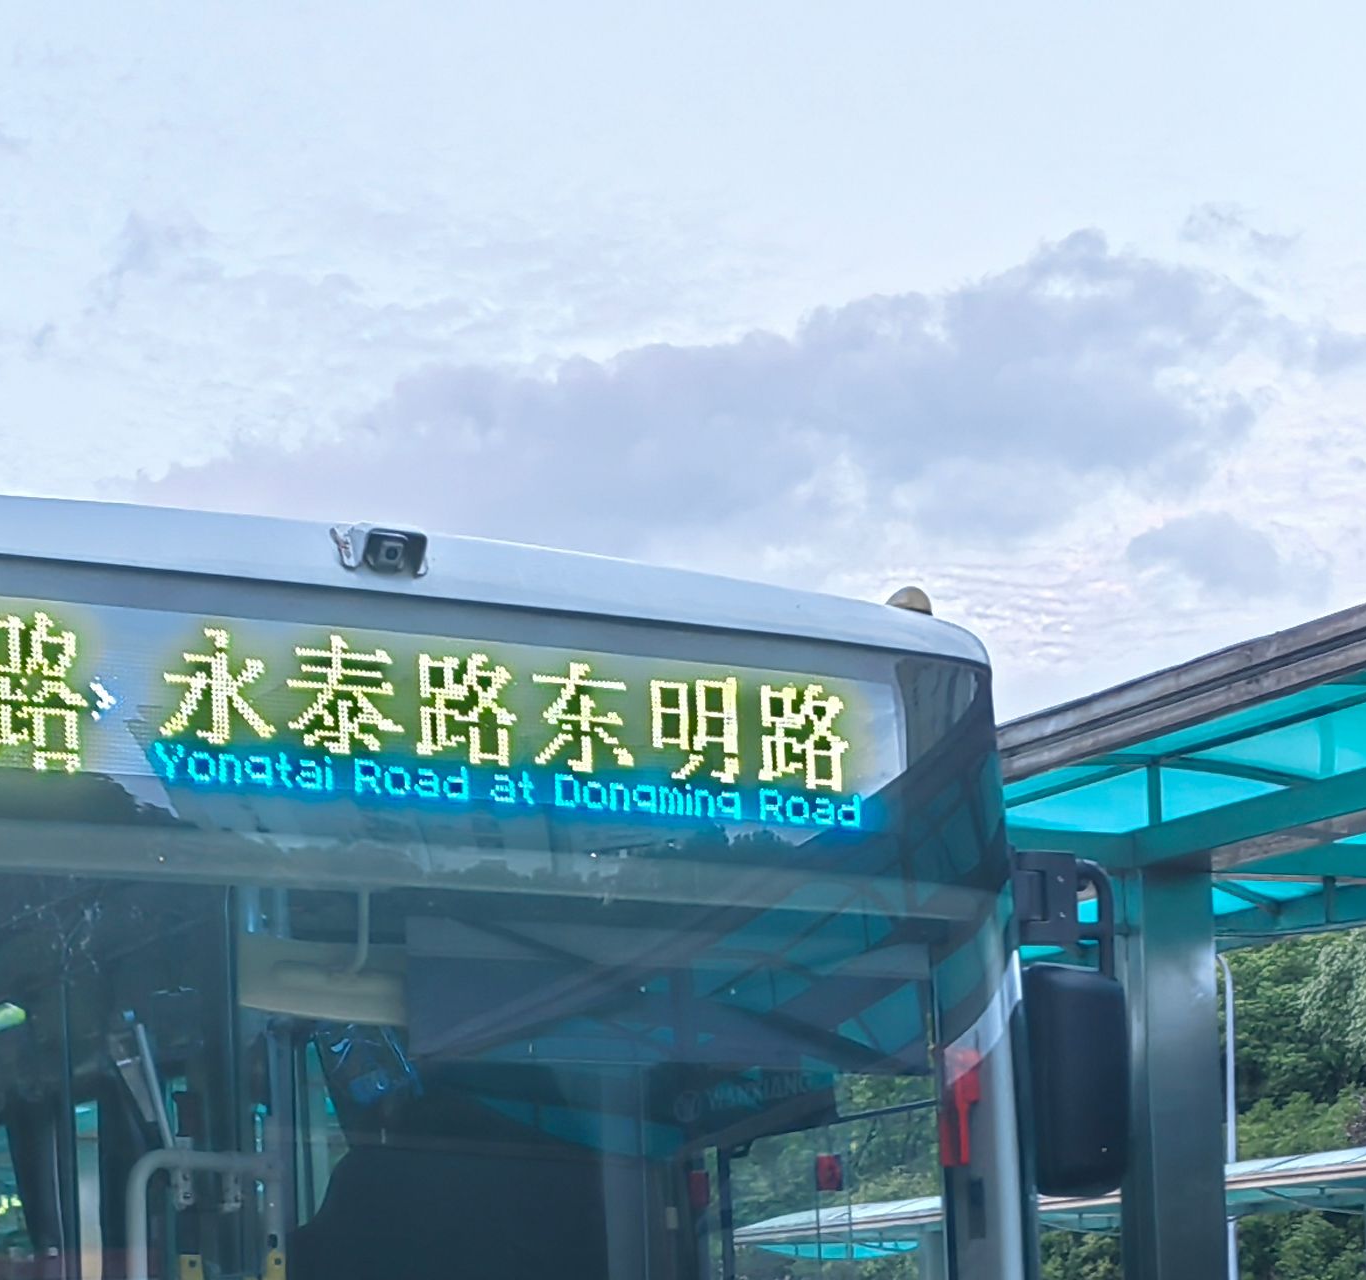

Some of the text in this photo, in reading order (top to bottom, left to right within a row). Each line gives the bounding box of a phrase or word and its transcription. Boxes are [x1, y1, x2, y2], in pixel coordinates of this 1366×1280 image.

[159, 628, 850, 791] 永泰路东明路
[354, 758, 469, 800] Road
[491, 771, 534, 804] at
[759, 788, 862, 828] Road
